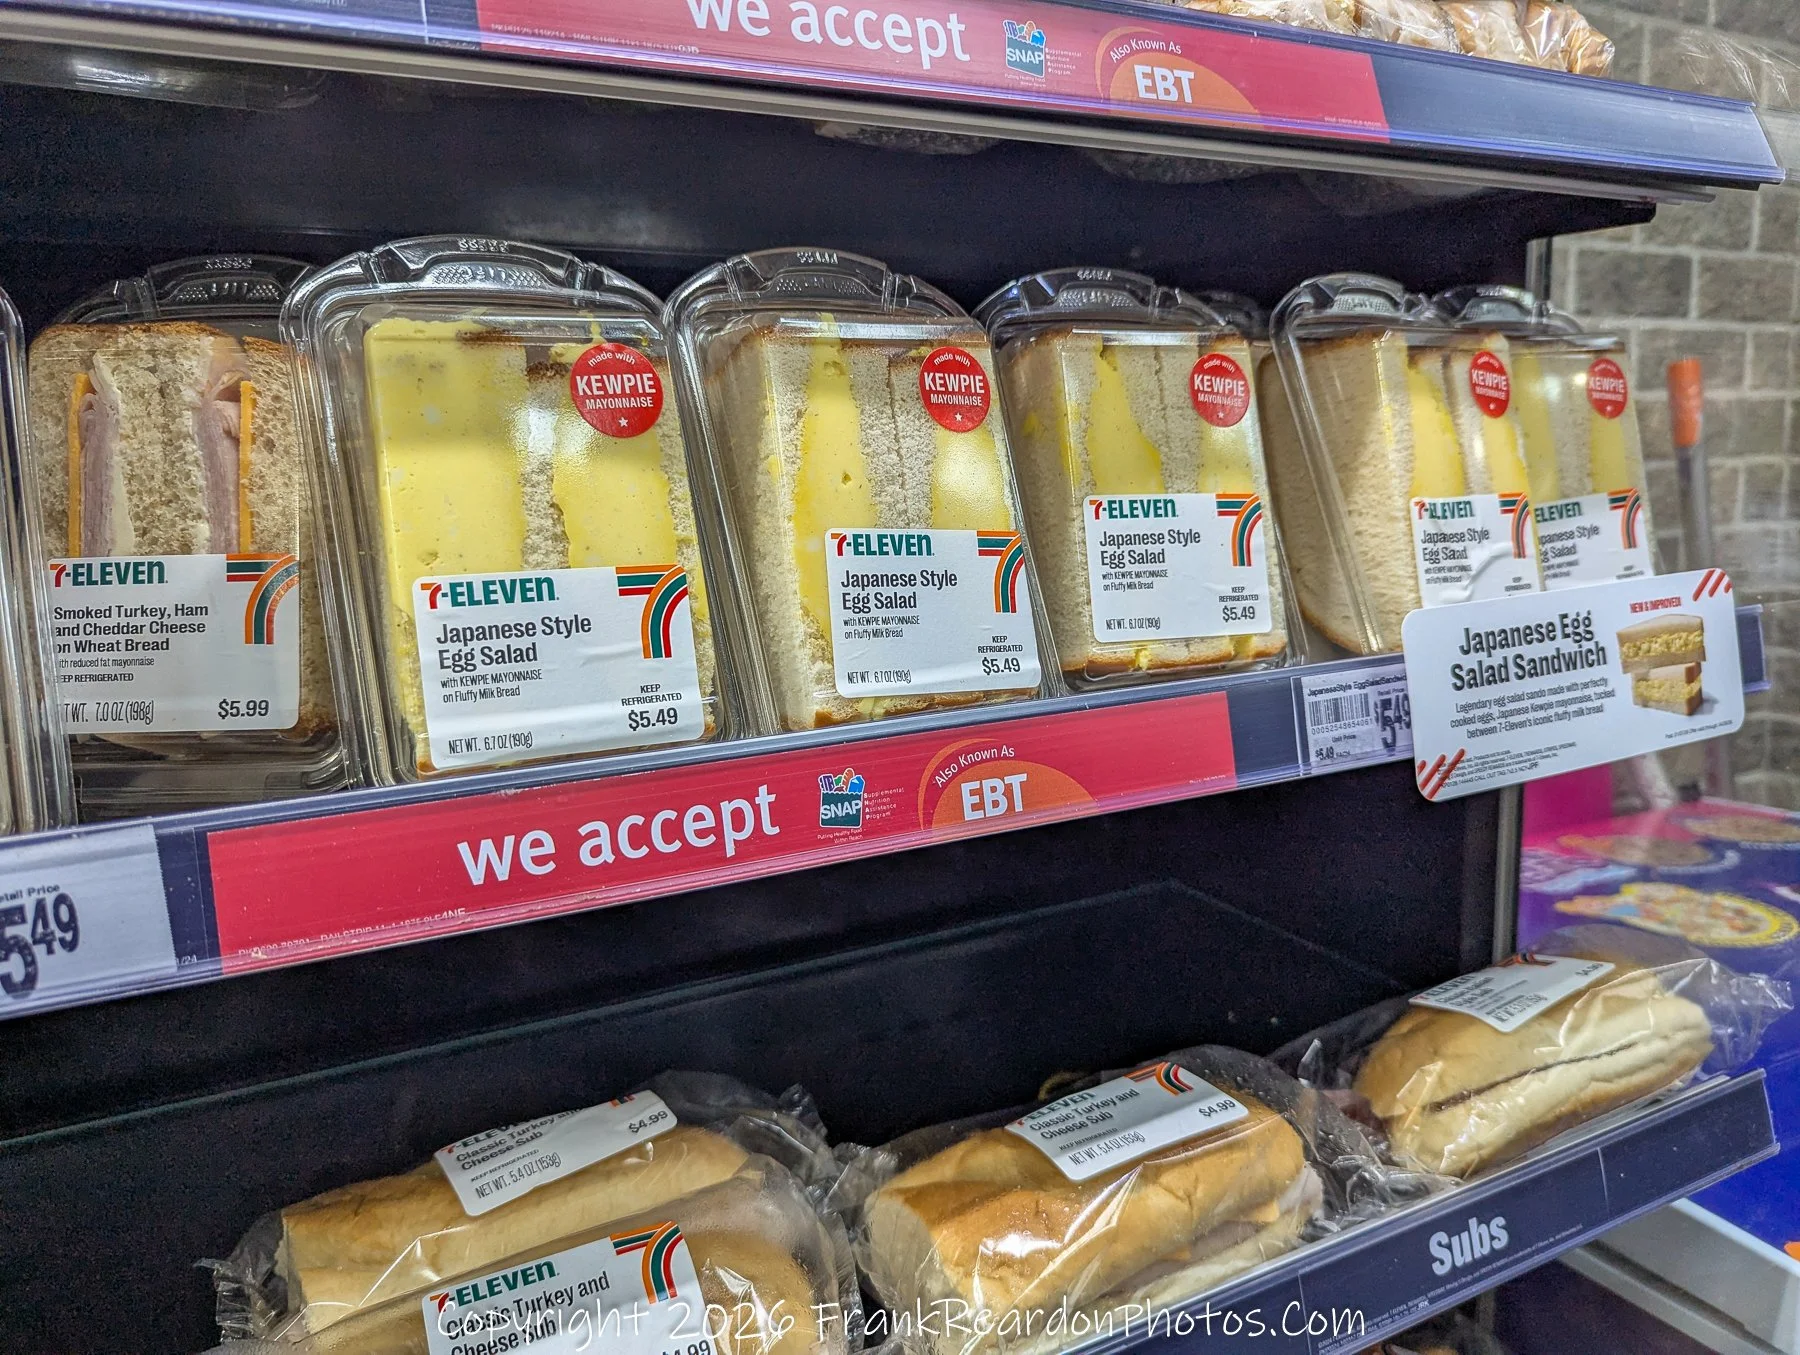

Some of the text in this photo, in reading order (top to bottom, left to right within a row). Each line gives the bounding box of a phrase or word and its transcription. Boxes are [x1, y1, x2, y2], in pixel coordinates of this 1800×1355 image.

[686, 0, 970, 70] we accept
[1007, 48, 1044, 64] SNAP
[1110, 39, 1182, 63] Also Known As
[1134, 65, 1195, 103] EBT
[588, 352, 635, 367] made with
[934, 352, 970, 367] made with
[576, 373, 656, 395] KEWPIE
[924, 372, 984, 393] KEWPIE
[1194, 373, 1245, 396] KEWPIE
[1472, 369, 1507, 390] KEWPIE
[1589, 378, 1624, 393] KEWPIE
[586, 397, 653, 409] MAYONNAISE
[931, 394, 982, 406] MAYONNAISE
[1198, 394, 1243, 406] MAYONNAISE
[1099, 529, 1200, 549] Japanese Style
[1421, 528, 1490, 544] Japanese Style
[1576, 525, 1599, 539] Style
[1100, 549, 1165, 568] Egg Salad
[1423, 548, 1440, 564] Egg
[840, 570, 957, 590] Japanese Style
[54, 604, 208, 620] Smoked Turkey, Ham
[842, 592, 917, 613] Egg Salad
[1630, 602, 1643, 613] NEW
[1649, 597, 1681, 610] IMPROVED!
[843, 615, 920, 626] with KEWPIE MAYONNAISE
[1222, 606, 1255, 622] $5.49
[55, 621, 205, 637] and Cheddar Cheese
[436, 614, 592, 647] Japanese Style
[854, 629, 871, 640] Fluffy
[872, 628, 884, 638] Milk
[885, 628, 903, 637] Bread
[1459, 610, 1594, 658] Japanese Egg
[74, 638, 169, 653] Wheat Bread
[978, 644, 1023, 653] REFRIGERATED
[992, 635, 1007, 643] KEEP
[70, 657, 154, 669] reduced fat mayonnaise
[438, 642, 537, 673] Egg Salad
[982, 657, 1020, 675] $5.49
[1450, 641, 1607, 691] Salad Sandwich
[75, 673, 133, 683] REFRIGERATED
[441, 669, 543, 688] with KEWPIE MAYONNAISE
[893, 669, 911, 684] (190g)
[443, 686, 521, 703] on Fluffy Milk Bread
[640, 684, 661, 694] KEEP
[1455, 677, 1608, 713] Legendary egg salad sando made with perfectly
[621, 693, 682, 706] REFRIGERATED
[1450, 688, 1615, 728] cooked eggs, Japanese Kewpie mayonnaise, tucked
[72, 702, 88, 722] WT.
[96, 702, 109, 721] 7.0
[111, 701, 124, 721] OZ
[125, 701, 154, 723] (198g)
[218, 699, 269, 720] $5.99
[628, 707, 678, 732] $5.49
[1466, 704, 1604, 739] between 7-Eleven's iconic fluffy milk bread
[449, 731, 533, 754] NET WT. 6.7 OZ (190g)
[934, 744, 1014, 787] Also Known As
[864, 787, 904, 798] Supplemental
[864, 797, 890, 805] Nutrition
[961, 773, 1027, 820] EBT
[821, 800, 861, 819] SNAP
[865, 804, 896, 812] Assistance
[866, 811, 891, 820] Program
[457, 784, 780, 886] we accept
[27, 883, 60, 897] Price
[1029, 1088, 1140, 1131] Classic Turkey and
[1198, 1099, 1236, 1118] $4.99
[628, 1110, 668, 1133] $4.99
[1040, 1110, 1113, 1139] Cheese Sub
[456, 1116, 555, 1162] Classic Turkey
[1123, 1131, 1146, 1146] (153g)
[462, 1131, 543, 1170] Cheese Sub
[474, 1151, 561, 1200] NET WT. 5.4 OZ (153g)
[1429, 1216, 1508, 1275] Subs
[446, 1271, 610, 1341] Classic Turkey and
[450, 1317, 558, 1355] Cheese Sub
